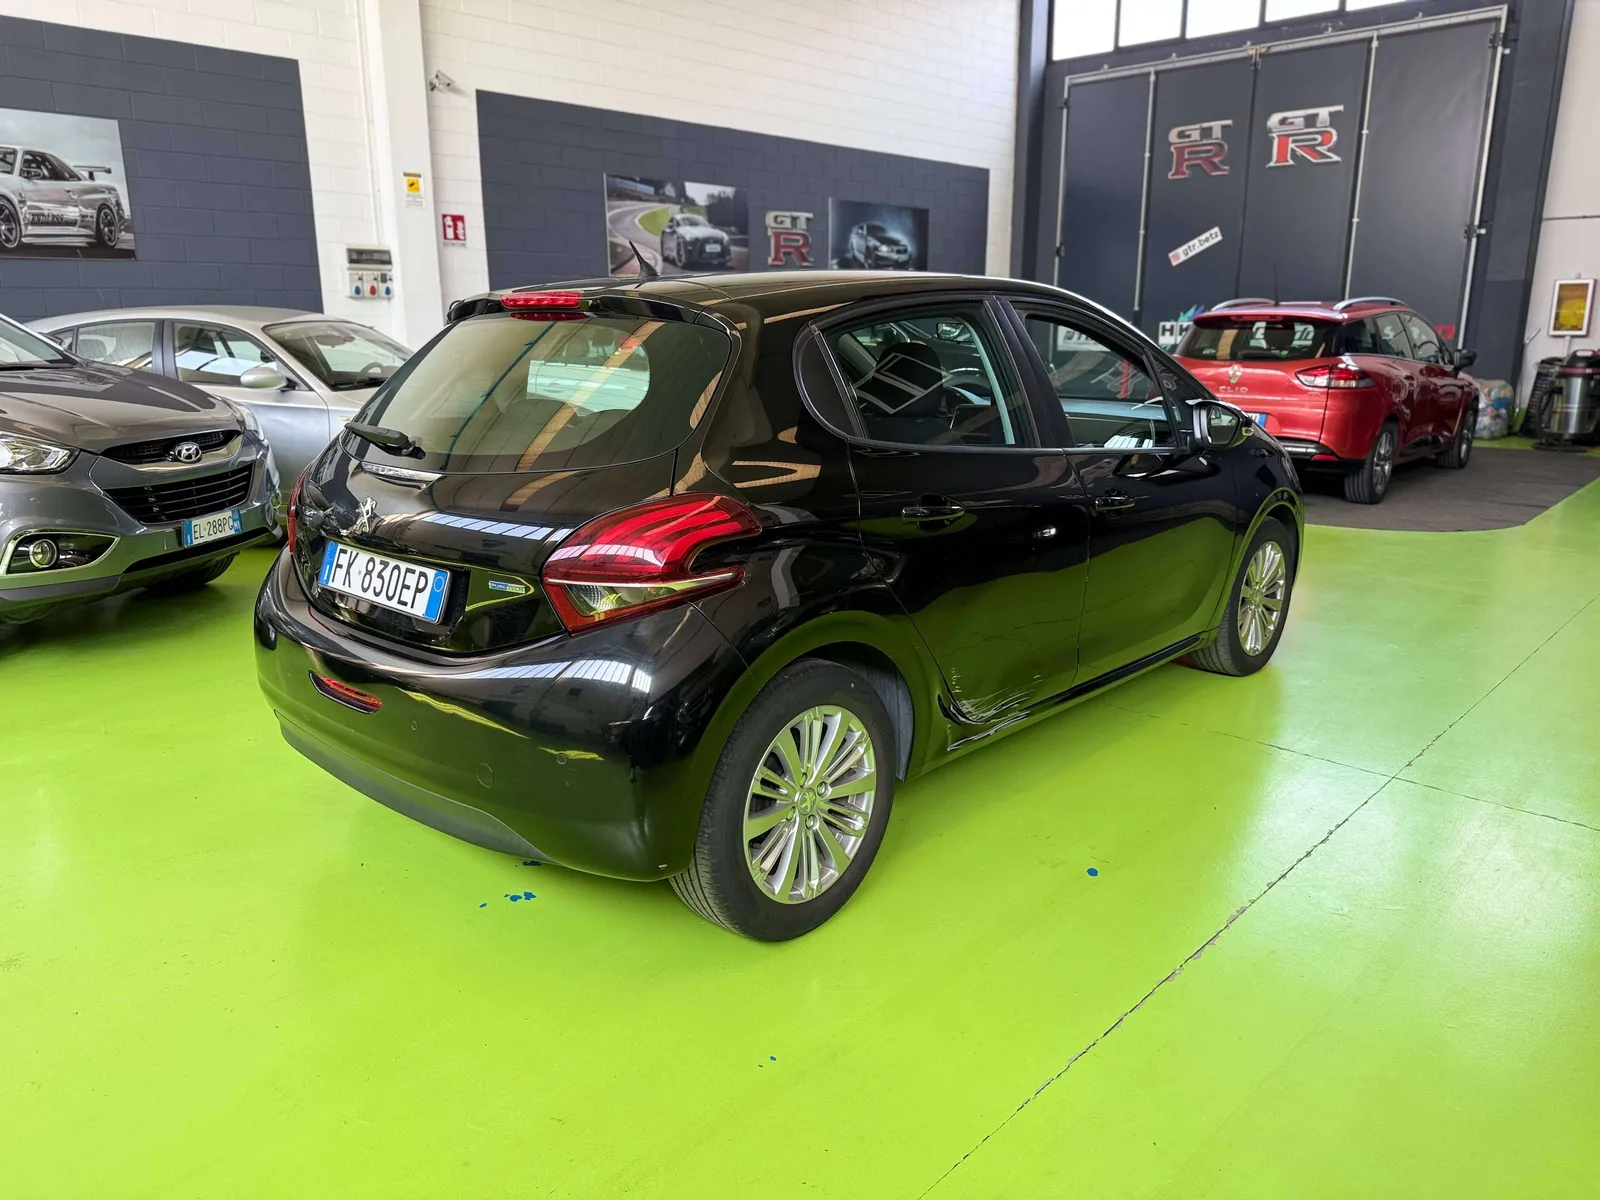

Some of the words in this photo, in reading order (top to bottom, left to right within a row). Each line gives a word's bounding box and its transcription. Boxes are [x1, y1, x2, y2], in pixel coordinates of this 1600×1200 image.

[1168, 119, 1233, 144] GT
[1266, 104, 1344, 133] GT
[1168, 140, 1230, 179] R
[1266, 127, 1342, 168] R
[765, 210, 814, 230] GT
[768, 228, 814, 266] R
[1182, 231, 1220, 257] gtr.betz
[331, 548, 359, 588] FK
[361, 556, 428, 609] 830EP
